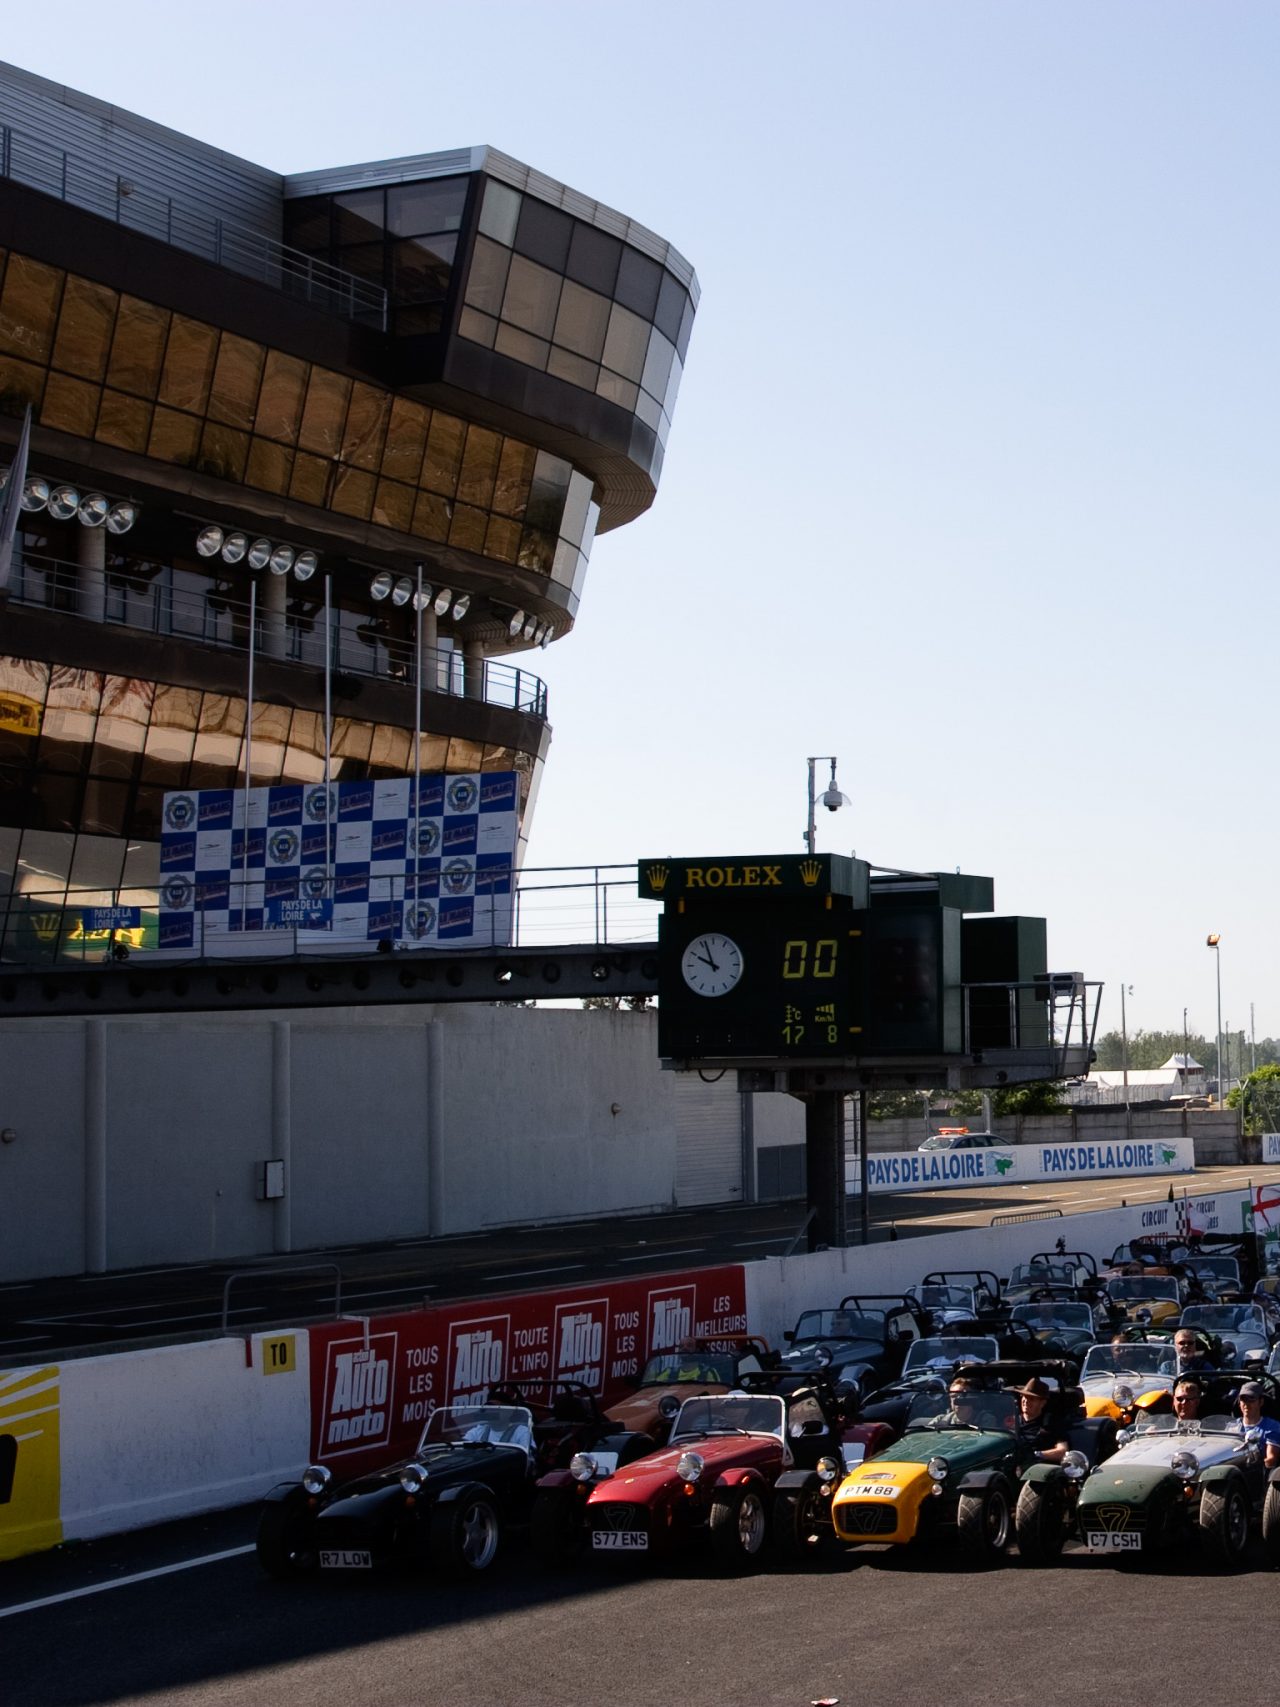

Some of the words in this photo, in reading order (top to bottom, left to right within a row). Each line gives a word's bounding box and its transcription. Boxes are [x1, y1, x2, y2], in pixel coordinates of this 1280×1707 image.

[685, 866, 782, 888] ROLEX
[94, 908, 111, 918] PAYS
[111, 908, 122, 918] DE
[123, 908, 132, 918] LA
[281, 900, 300, 910] PAYS
[300, 900, 311, 910] DE
[312, 899, 323, 909] LA
[94, 919, 115, 929] LOIRE
[281, 910, 305, 921] LOIRE
[782, 939, 838, 979] 00
[781, 1025, 805, 1044] 17
[827, 1025, 838, 1043] 8
[1043, 1148, 1076, 1172] PAYS
[1078, 1147, 1096, 1170] DE
[1097, 1146, 1116, 1169] LA
[1117, 1144, 1154, 1168] LOIRE
[867, 1158, 900, 1185] PAYS
[901, 1157, 920, 1182] DE
[922, 1155, 941, 1181] LA
[942, 1153, 985, 1180] LOIRE
[1141, 1209, 1168, 1227] CIRCUIT
[713, 1296, 731, 1313] LES
[614, 1311, 640, 1331] TOUS
[696, 1314, 747, 1337] MEILLEURS
[514, 1327, 549, 1349] TOUTE
[616, 1335, 635, 1354] LES
[706, 1340, 737, 1353] SSAIS
[406, 1345, 439, 1369] TOUS
[512, 1352, 549, 1374] L'INFO
[611, 1358, 638, 1378] MOIS
[409, 1372, 433, 1395] LES
[402, 1398, 437, 1423] MOIS
[327, 1408, 386, 1445] moto
[845, 1486, 872, 1496] PTM
[594, 1532, 618, 1546] S77
[621, 1533, 647, 1546] ENS
[1090, 1533, 1108, 1547] C7
[1111, 1533, 1139, 1547] CSH
[322, 1553, 339, 1566] R7
[343, 1553, 370, 1566] LOW
